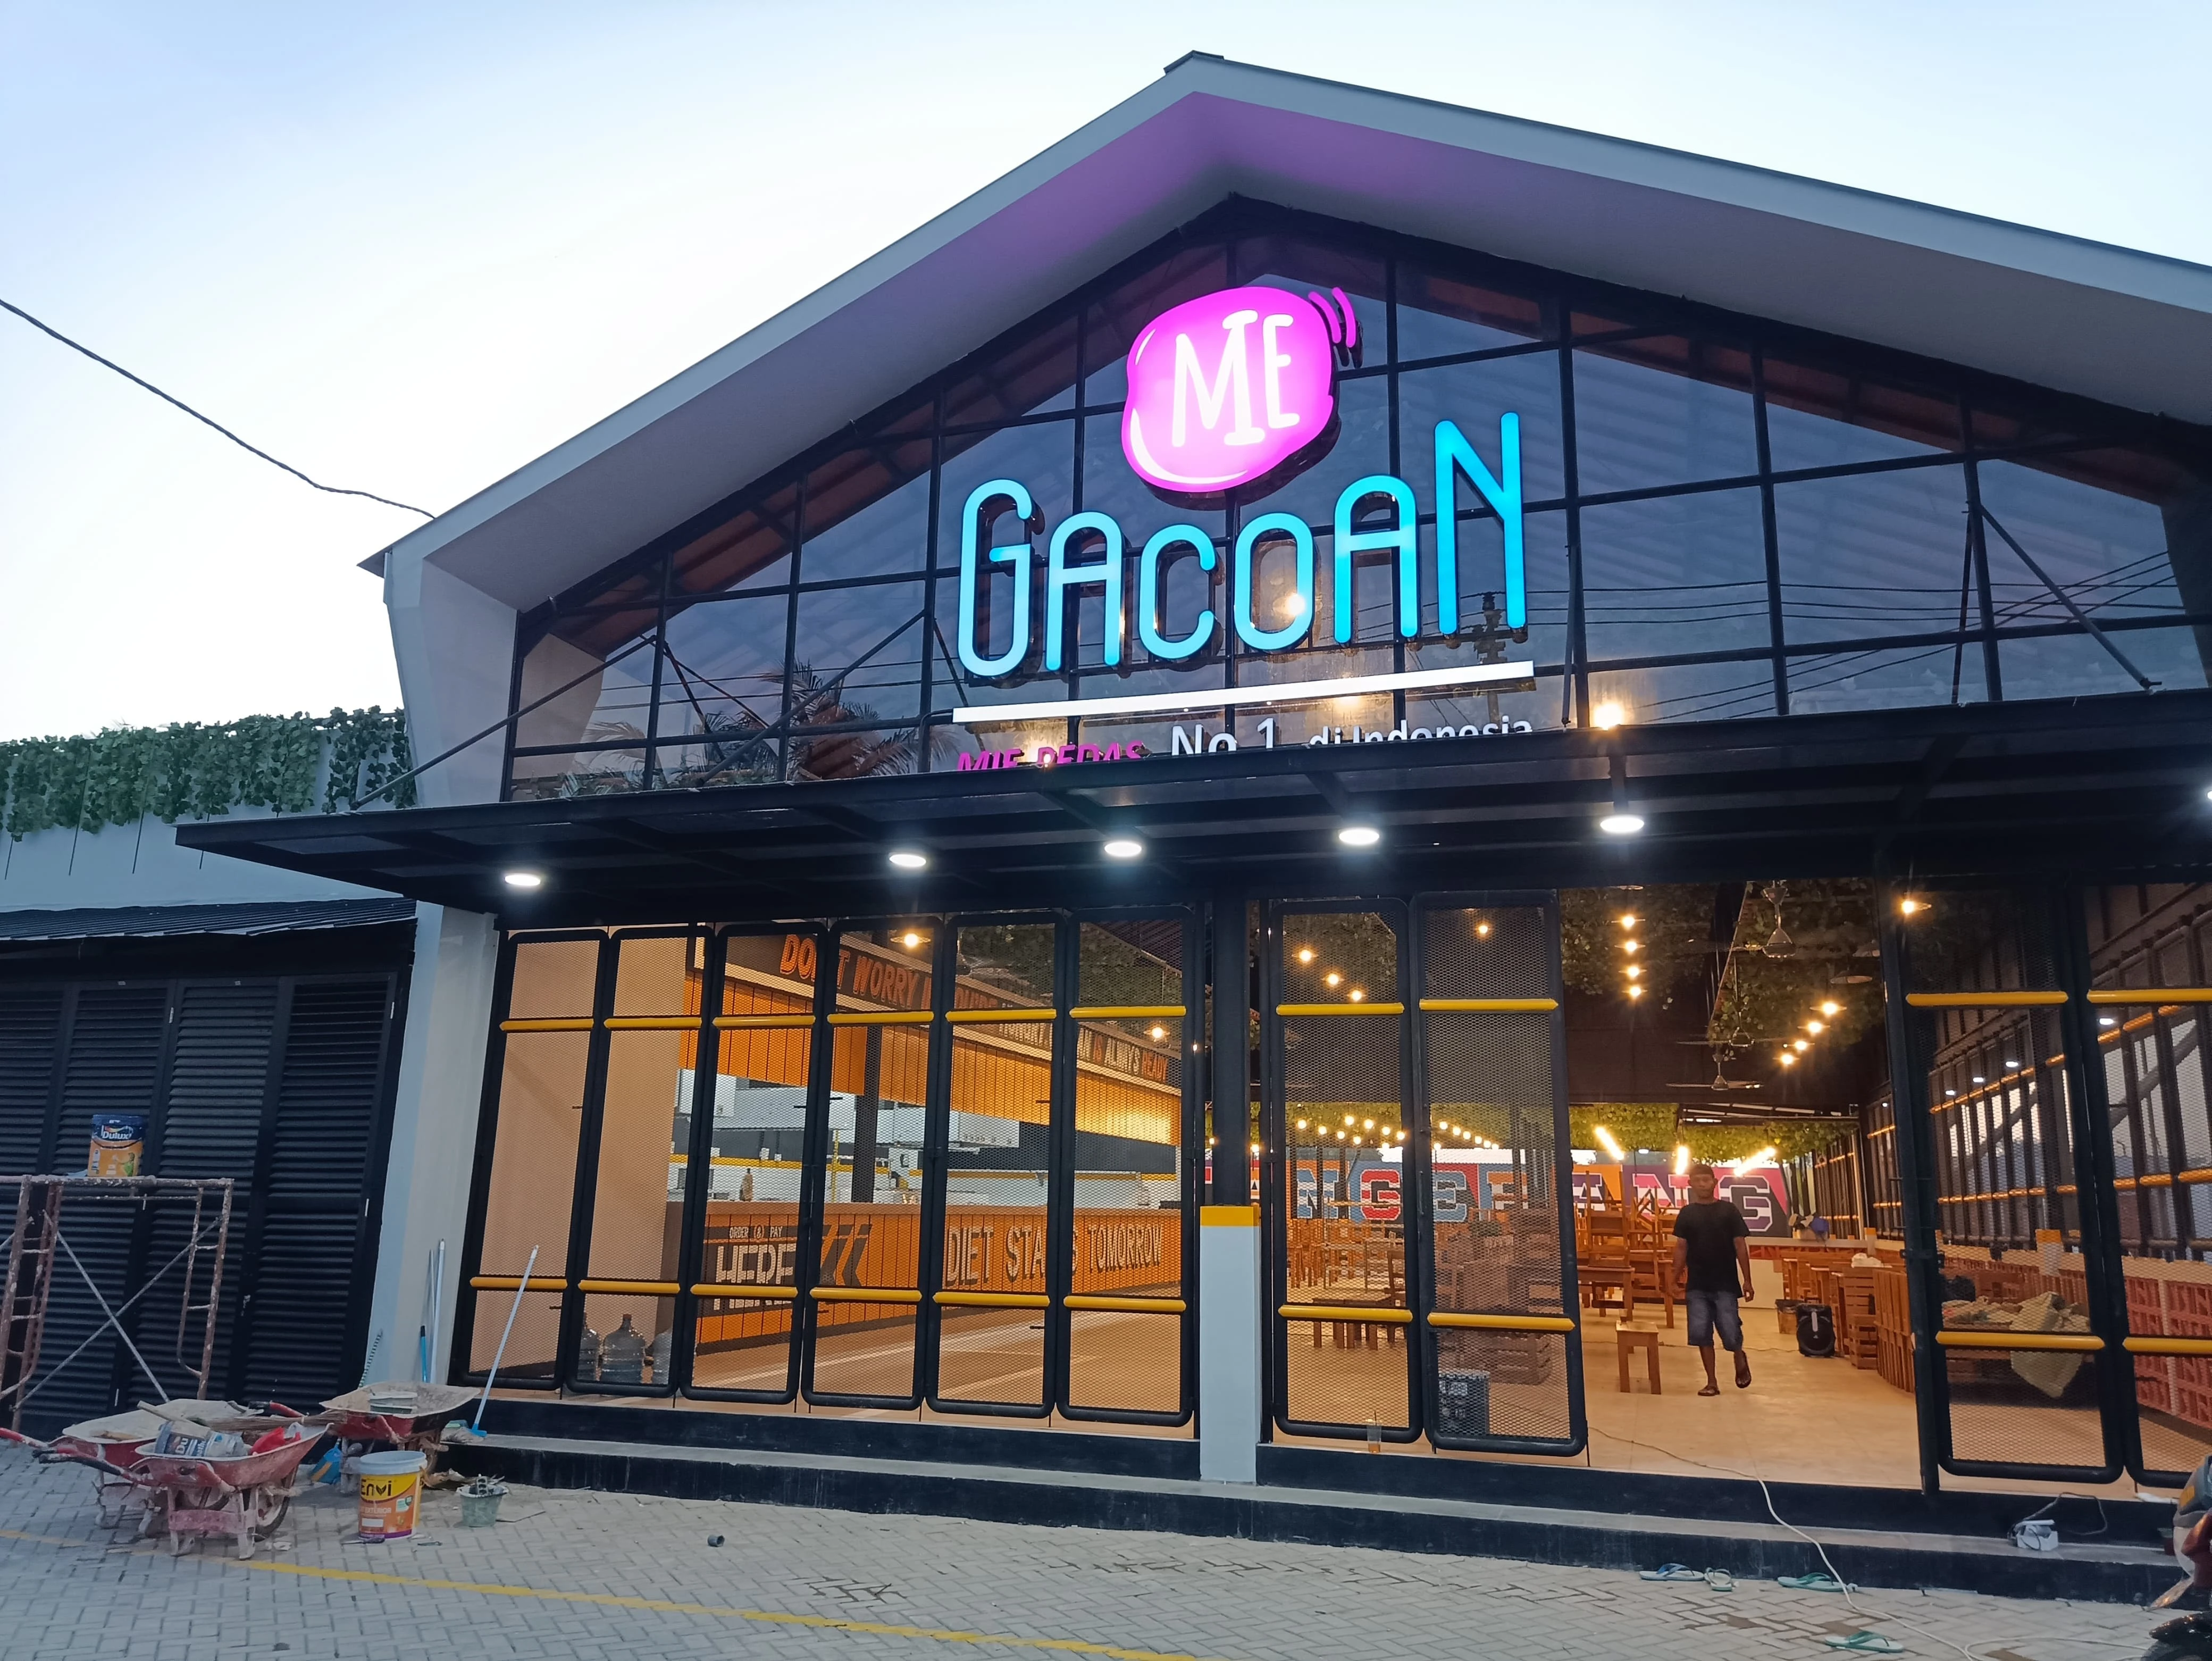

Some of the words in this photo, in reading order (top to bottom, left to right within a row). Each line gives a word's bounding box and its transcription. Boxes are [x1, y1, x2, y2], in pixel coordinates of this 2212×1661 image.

[958, 413, 1526, 676] GACOAN
[853, 955, 919, 1009] WORRY
[102, 1131, 130, 1139] Dulux
[729, 1226, 750, 1239] ORDER
[770, 1226, 783, 1238] PAY
[946, 1226, 993, 1285] DIET
[1006, 1224, 1078, 1280] STAS
[1088, 1222, 1162, 1271] TOMORROW
